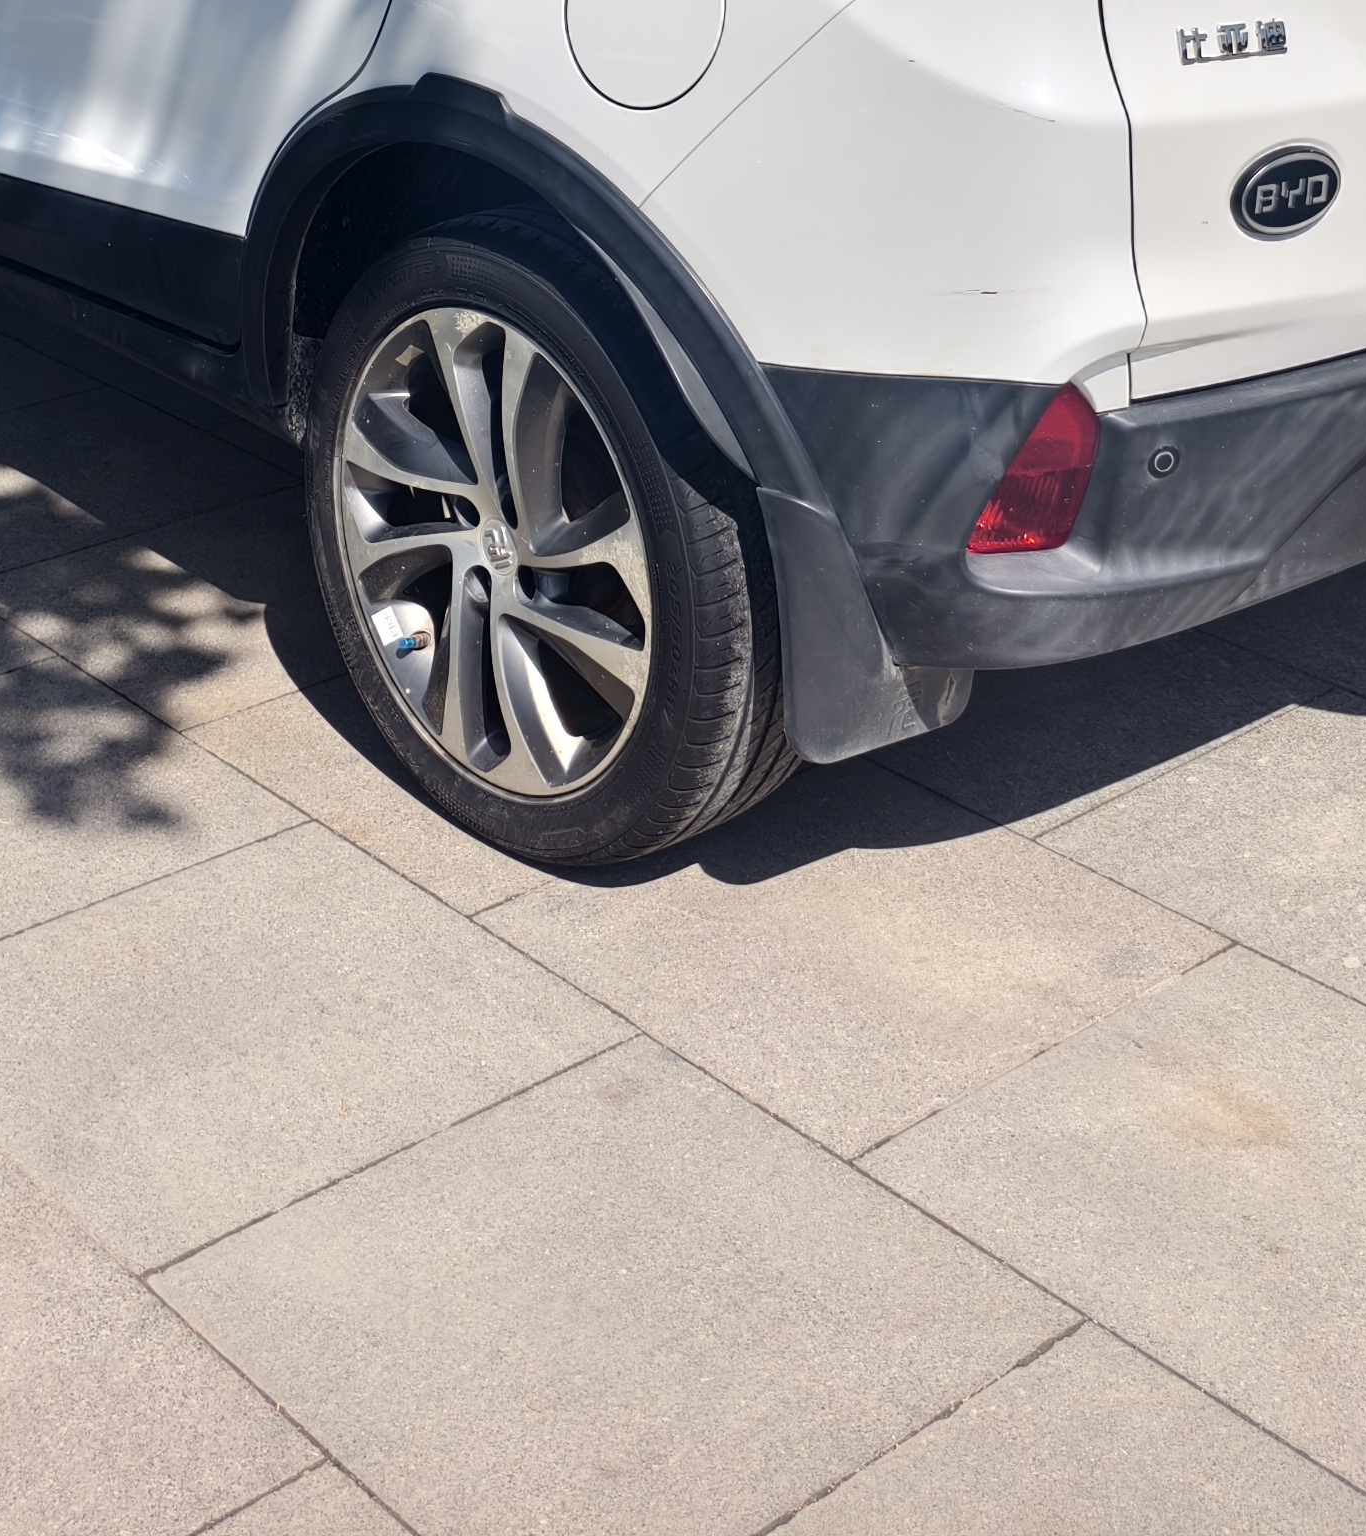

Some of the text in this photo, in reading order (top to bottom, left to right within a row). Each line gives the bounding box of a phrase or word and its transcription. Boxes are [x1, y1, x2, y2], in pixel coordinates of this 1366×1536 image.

[1175, 18, 1288, 66] 比亚迪
[1253, 173, 1330, 215] BYD
